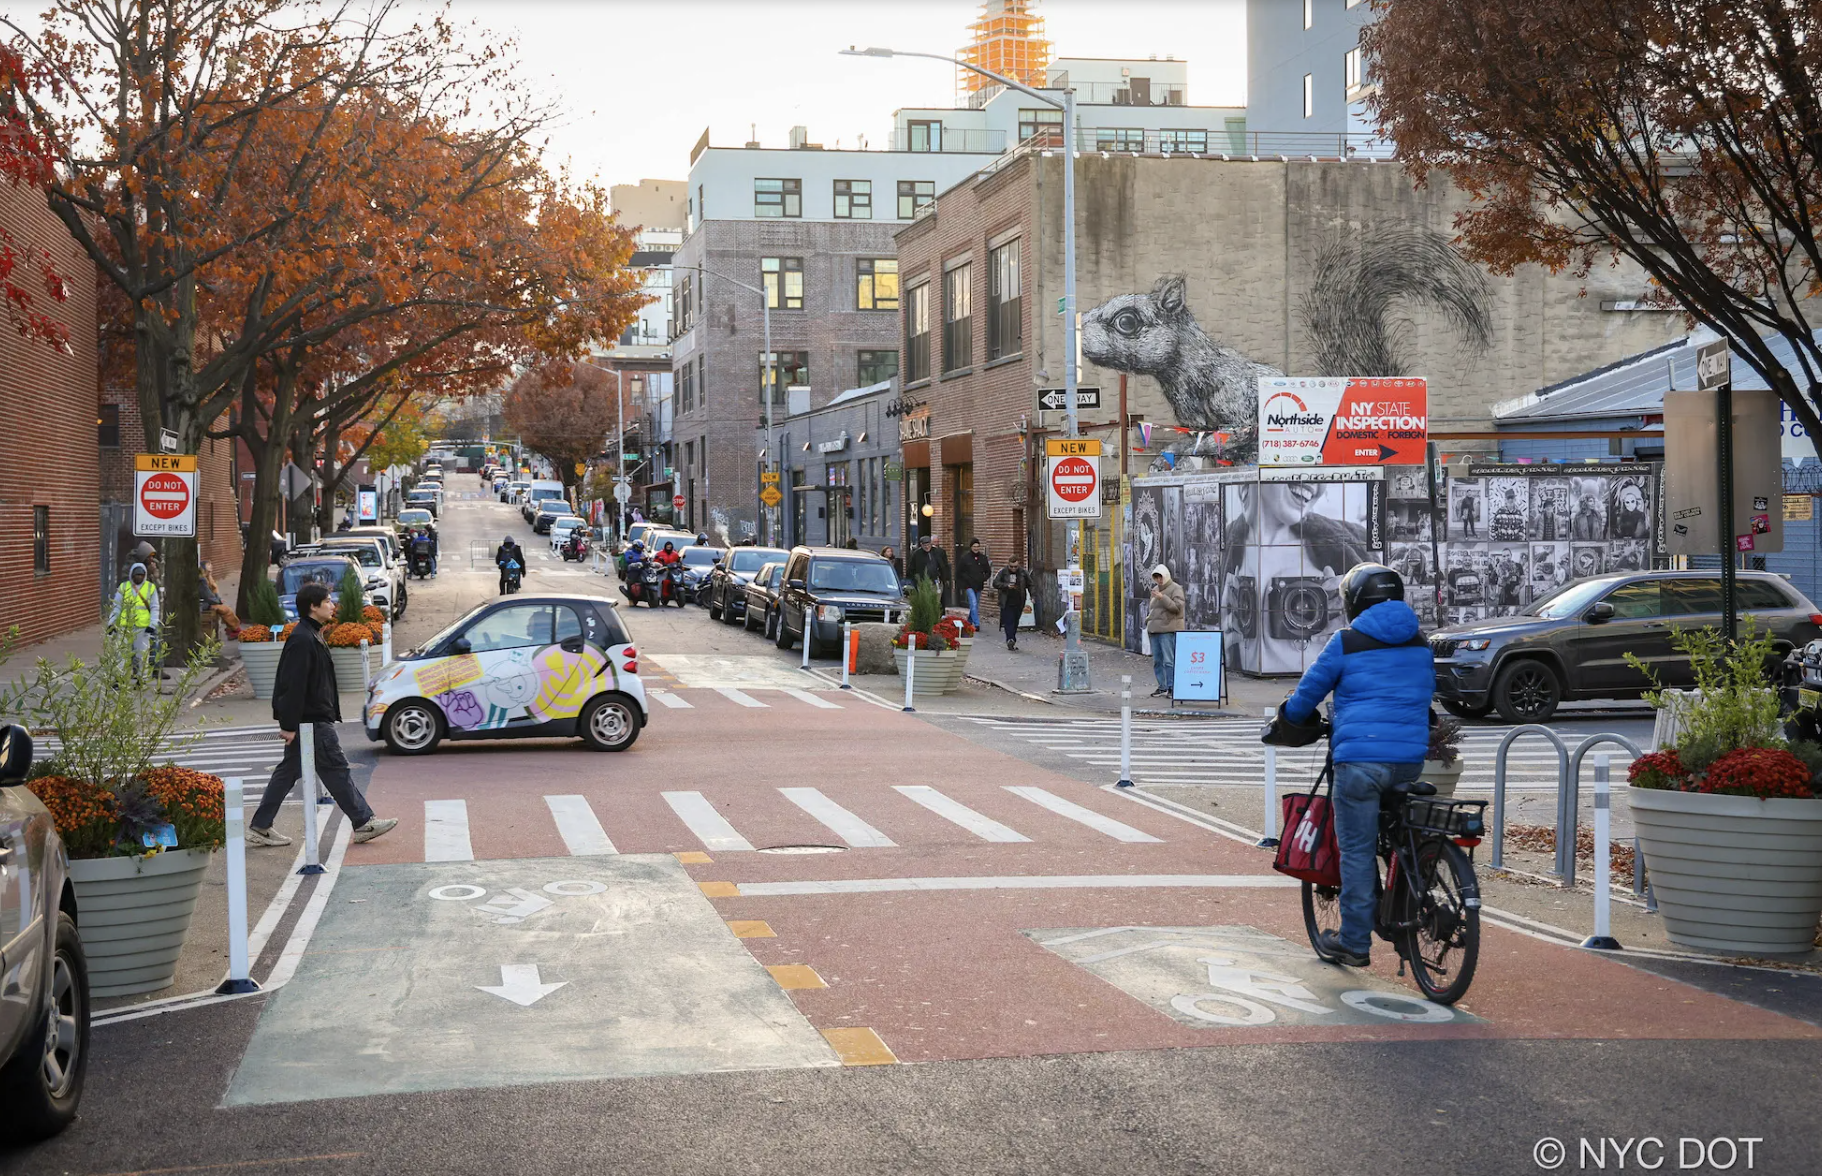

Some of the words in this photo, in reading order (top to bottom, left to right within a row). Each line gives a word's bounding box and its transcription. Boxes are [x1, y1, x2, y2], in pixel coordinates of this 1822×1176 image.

[1048, 395, 1066, 405] ONE
[1351, 402, 1374, 416] NY
[1376, 402, 1411, 416] STATE
[1267, 413, 1324, 427] Northside
[1336, 416, 1425, 430] INSPECTION
[1336, 431, 1379, 439] DOMESTIC
[1387, 431, 1425, 439] FOREIGN
[1061, 443, 1086, 453] NEW
[1262, 440, 1281, 449] (718)
[1282, 440, 1320, 448] 387-6746
[1354, 448, 1378, 456] ENTER
[151, 458, 180, 469] NEW
[1058, 465, 1070, 473] DO
[1073, 465, 1090, 473] NOT
[148, 481, 161, 490] DO
[163, 481, 182, 490] NOT
[1060, 485, 1088, 494] ENTER
[149, 502, 180, 511] ENTER
[140, 524, 166, 532] EXCEPT
[1190, 651, 1205, 664] $3
